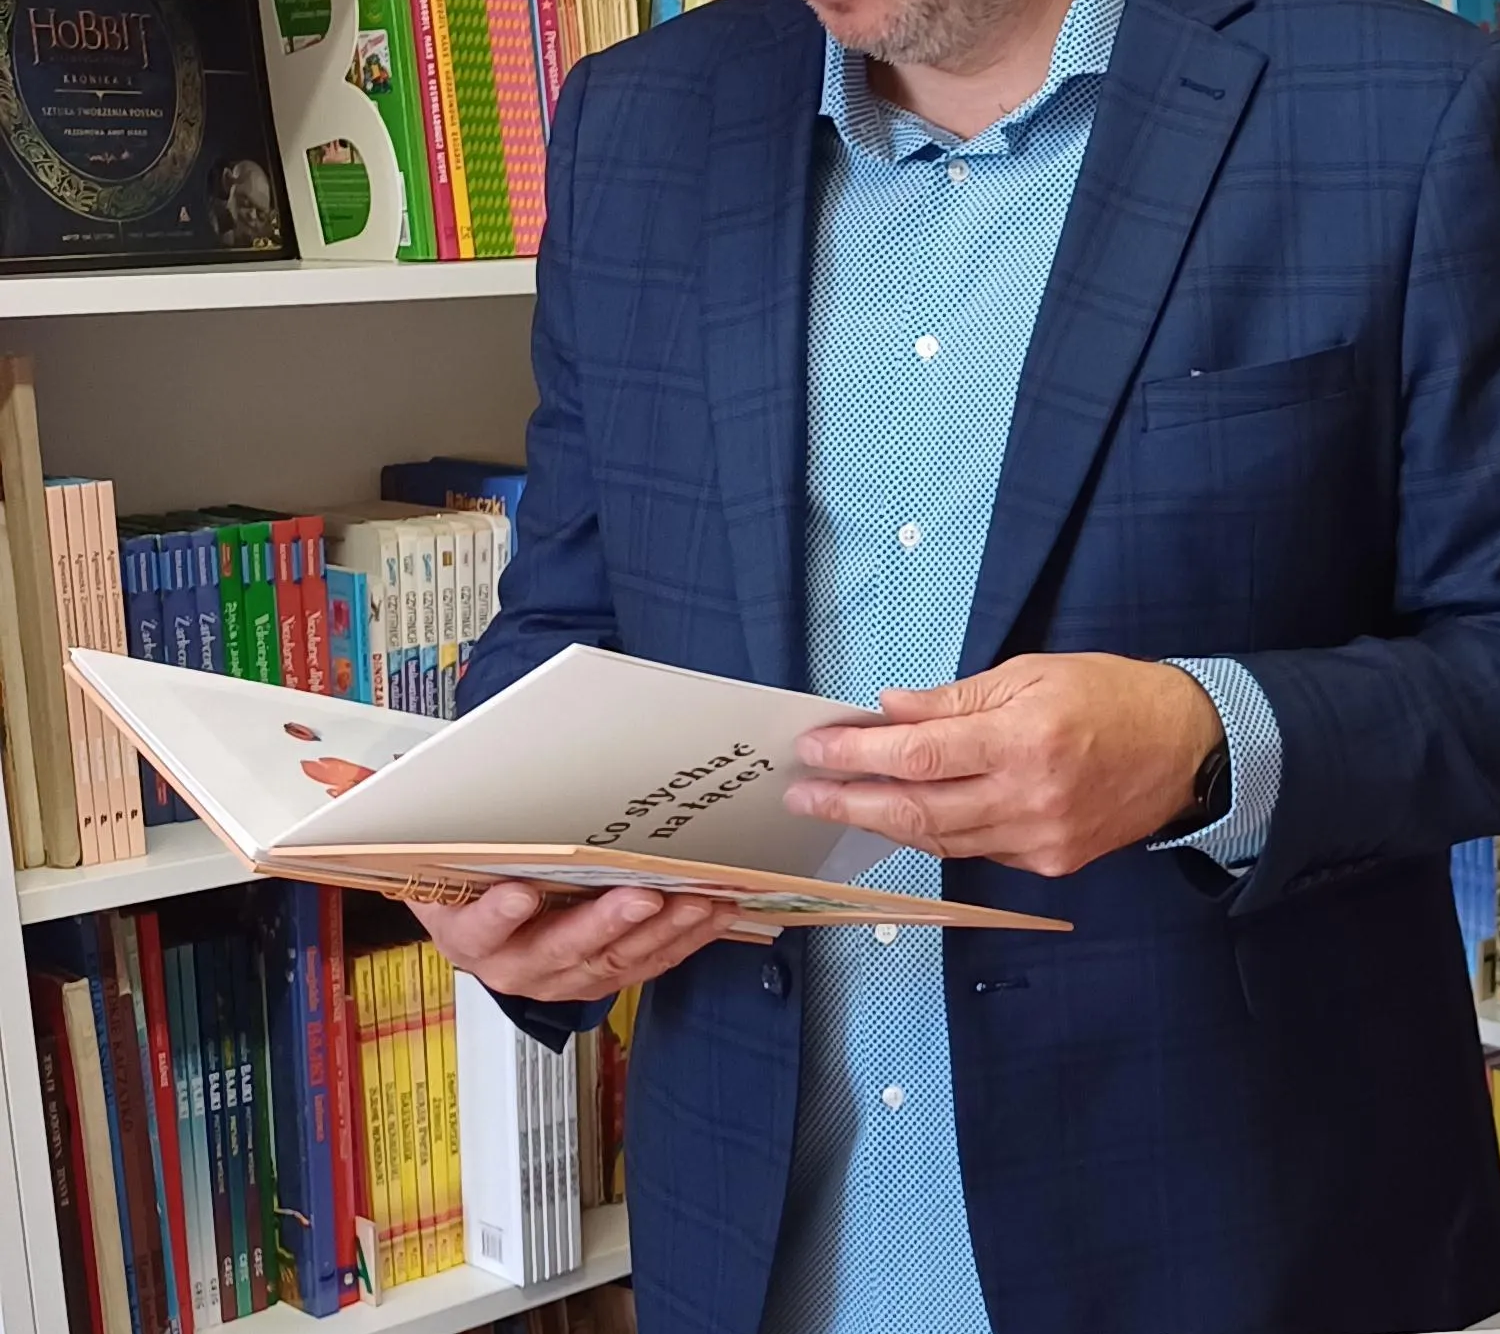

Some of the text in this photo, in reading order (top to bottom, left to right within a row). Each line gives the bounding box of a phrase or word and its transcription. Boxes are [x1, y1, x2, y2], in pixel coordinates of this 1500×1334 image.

[586, 741, 757, 849] Co słychać
[648, 759, 775, 841] na łące?
